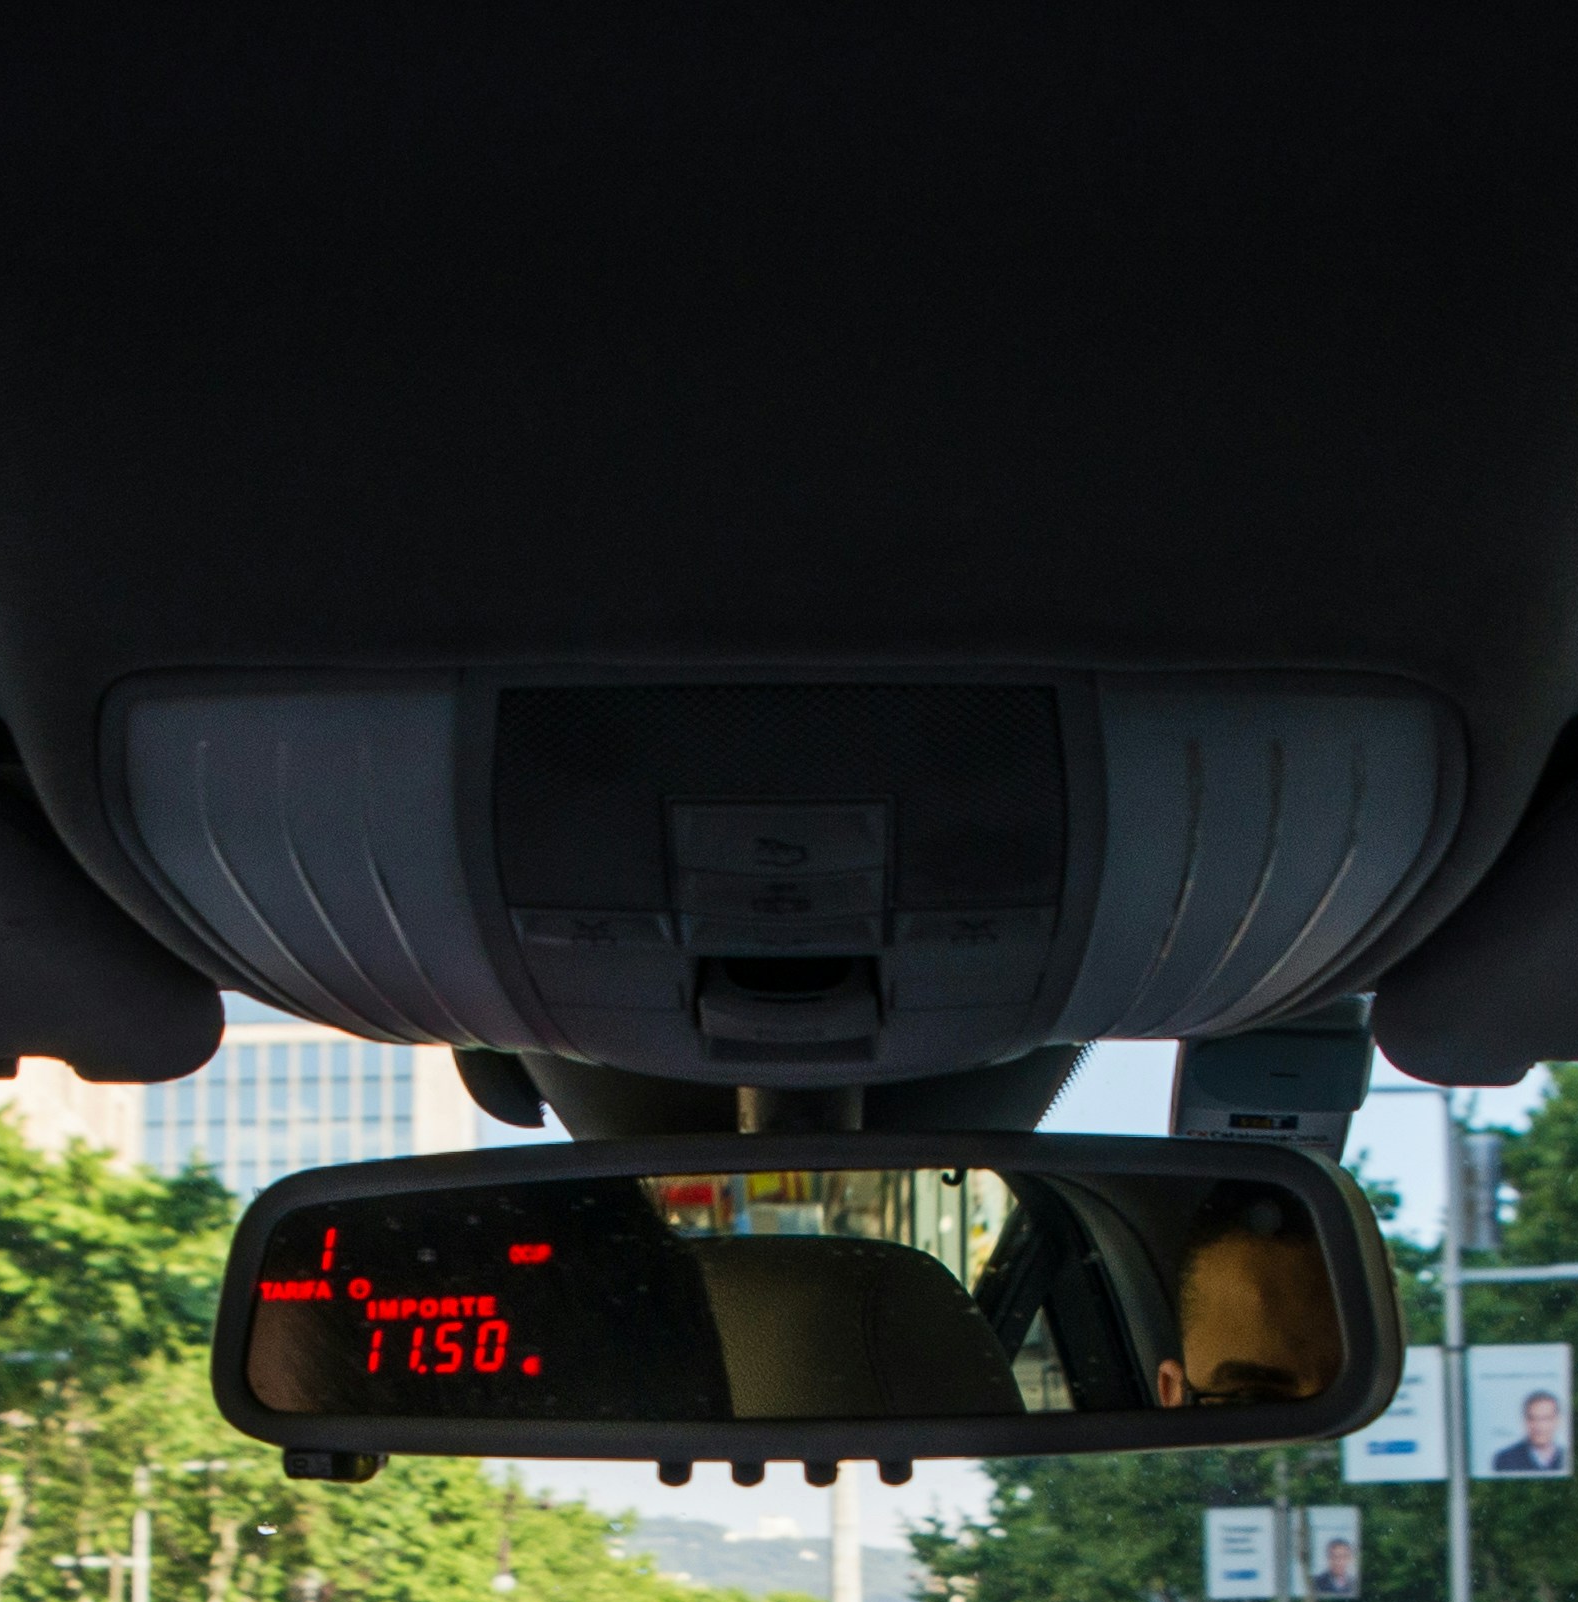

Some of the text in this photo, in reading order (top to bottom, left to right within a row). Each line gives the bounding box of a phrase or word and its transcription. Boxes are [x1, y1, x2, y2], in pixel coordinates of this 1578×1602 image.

[322, 1227, 337, 1271] 1
[260, 1280, 332, 1301] TARIFA
[367, 1296, 496, 1320] IMPORTE
